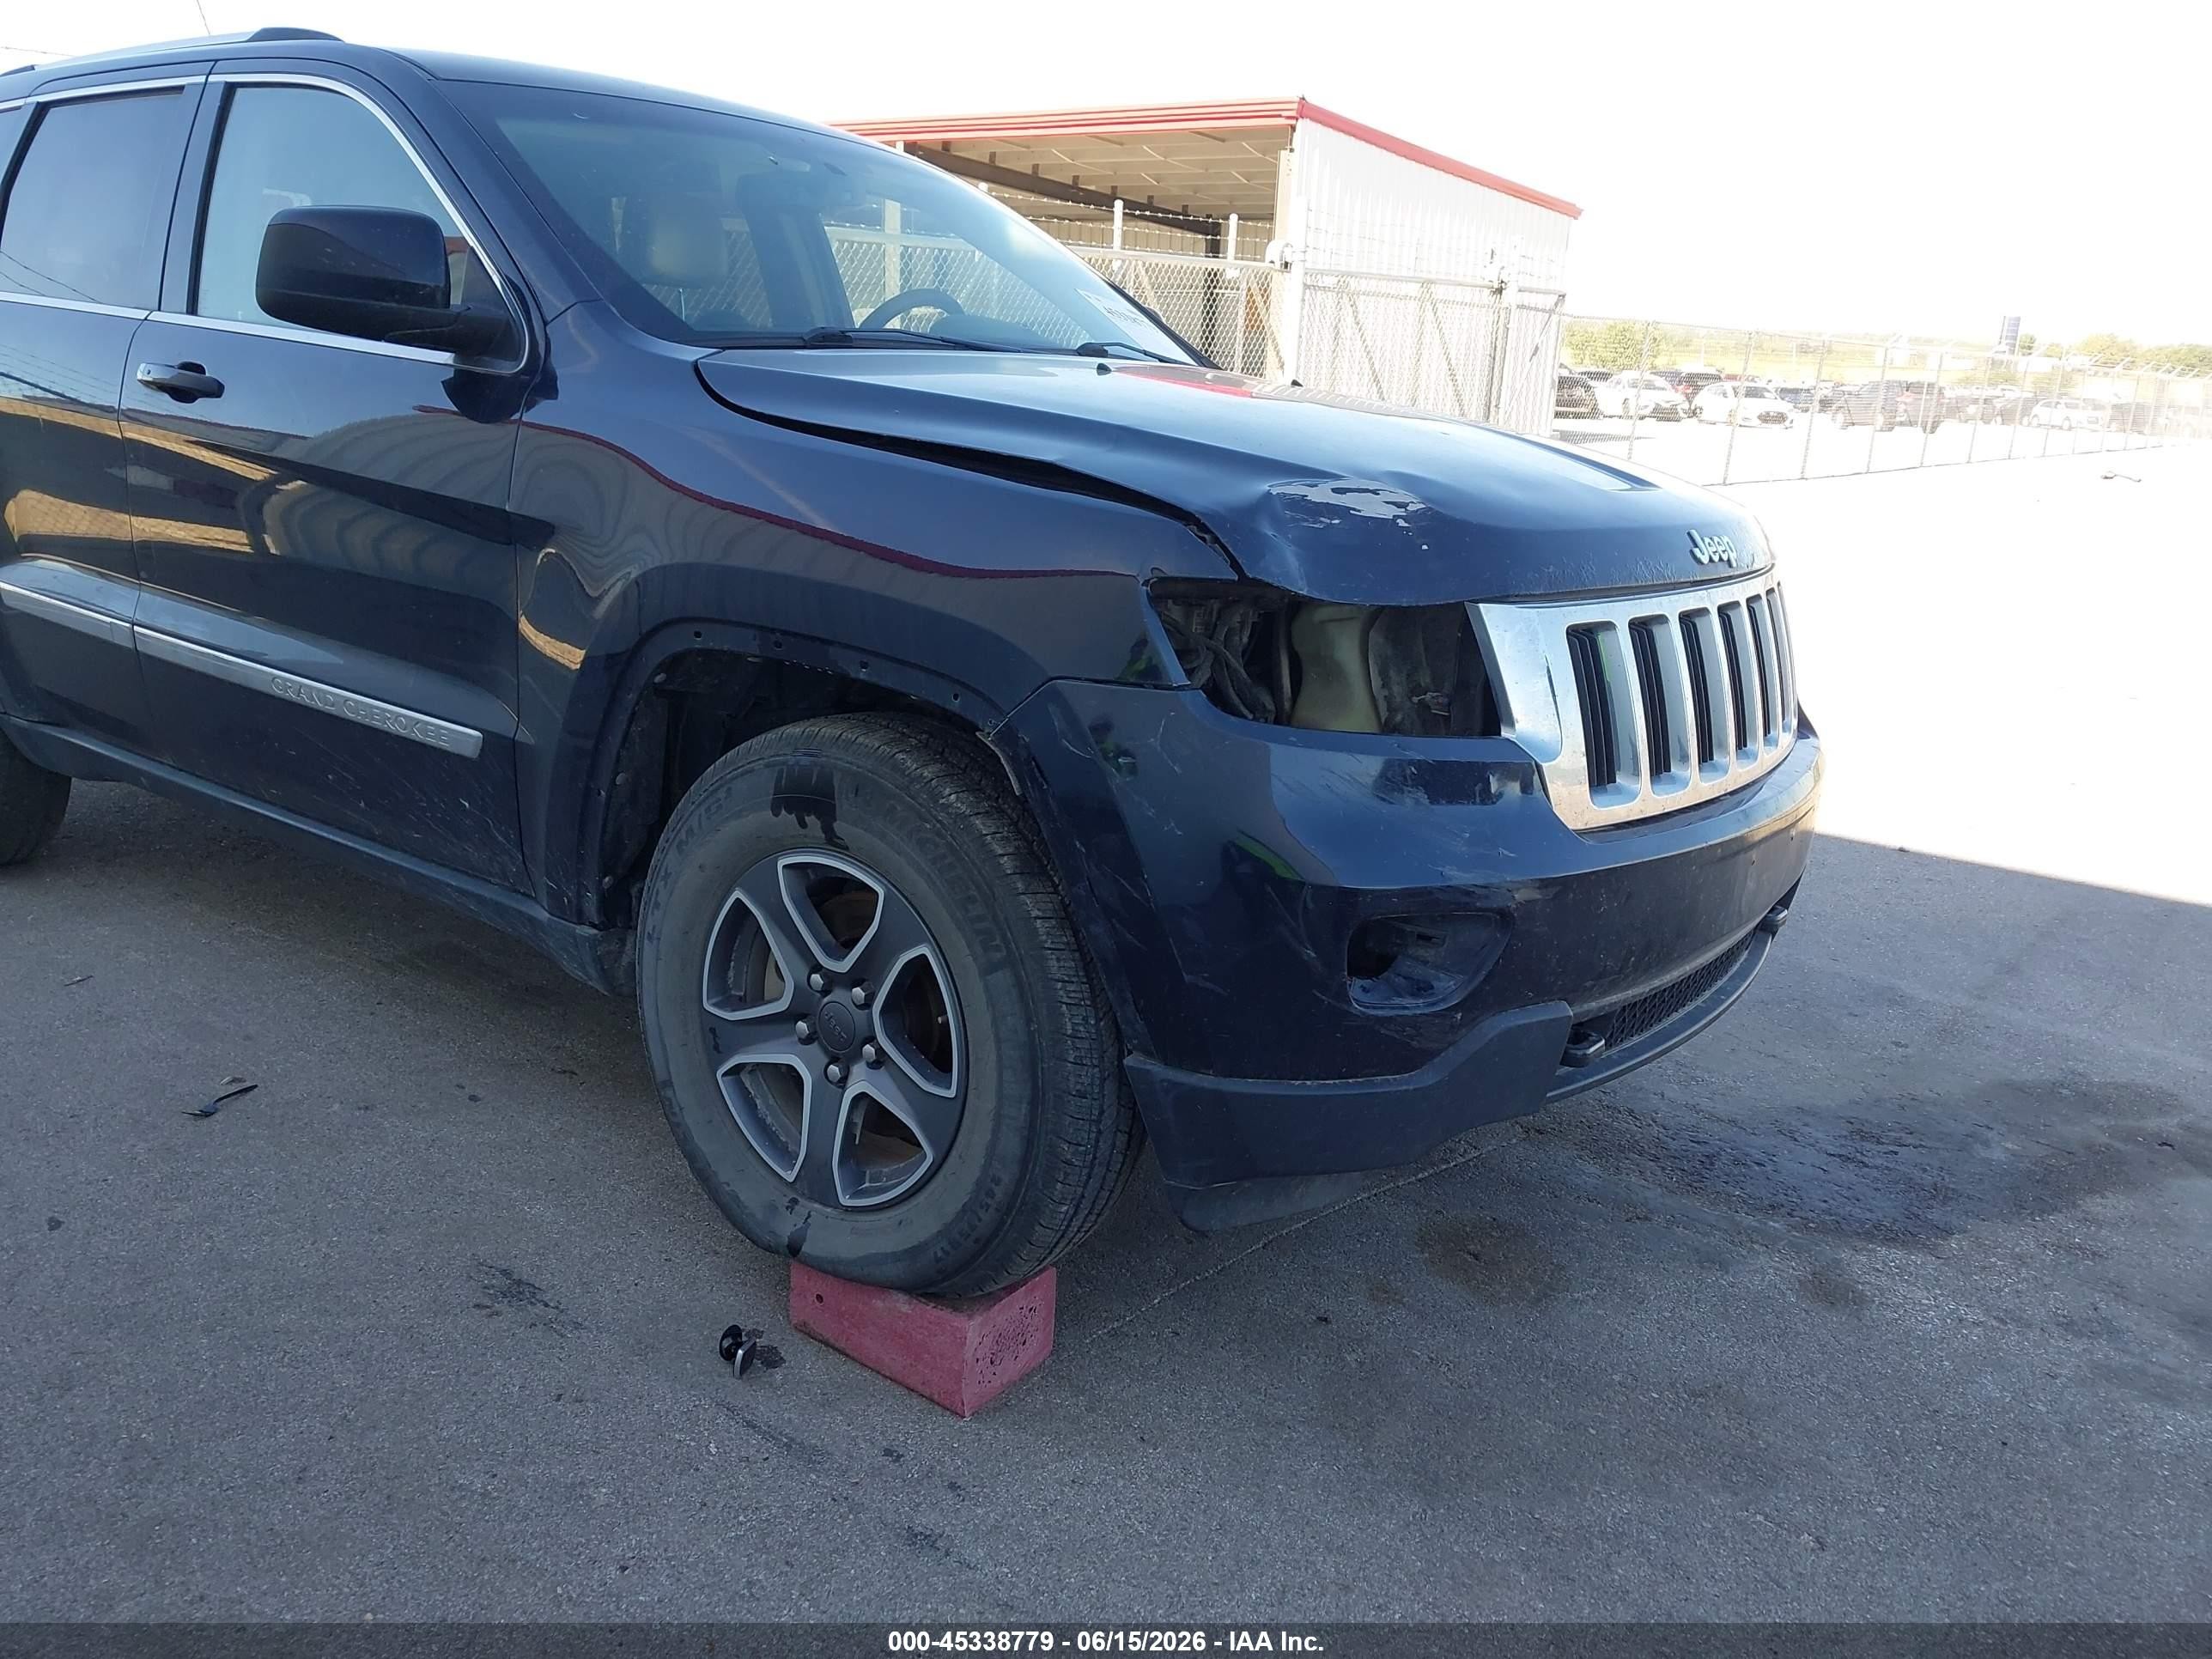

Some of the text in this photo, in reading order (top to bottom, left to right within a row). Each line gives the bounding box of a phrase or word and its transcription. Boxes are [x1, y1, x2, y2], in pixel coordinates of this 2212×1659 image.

[1686, 529, 1737, 568] Jeep
[270, 677, 451, 747] GRAND CHEROKEE
[824, 1012, 848, 1042] Jeep
